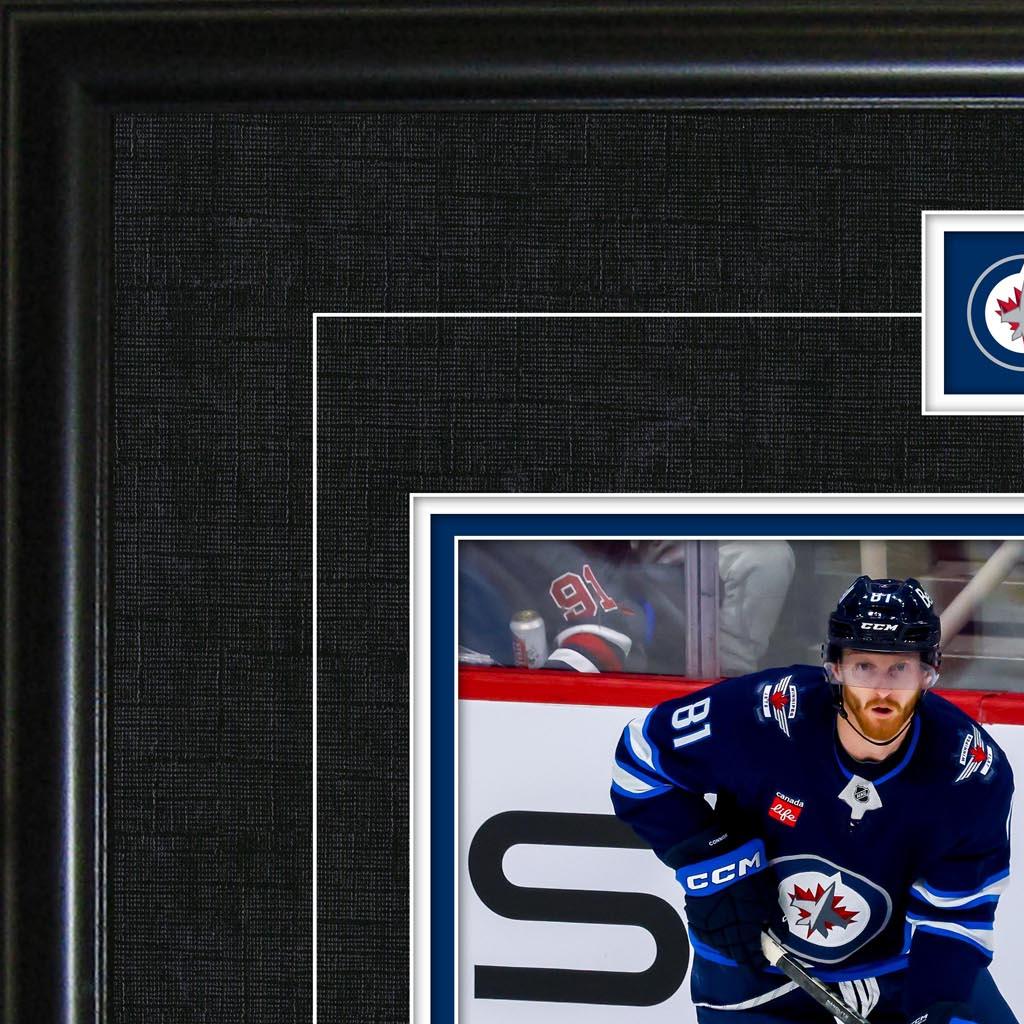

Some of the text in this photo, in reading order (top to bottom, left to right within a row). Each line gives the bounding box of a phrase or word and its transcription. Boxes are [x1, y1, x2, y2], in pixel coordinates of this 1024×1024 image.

[861, 622, 899, 632] CCM
[672, 697, 711, 748] 81
[776, 791, 804, 808] canada
[771, 804, 797, 821] life
[686, 851, 760, 890] CCM
